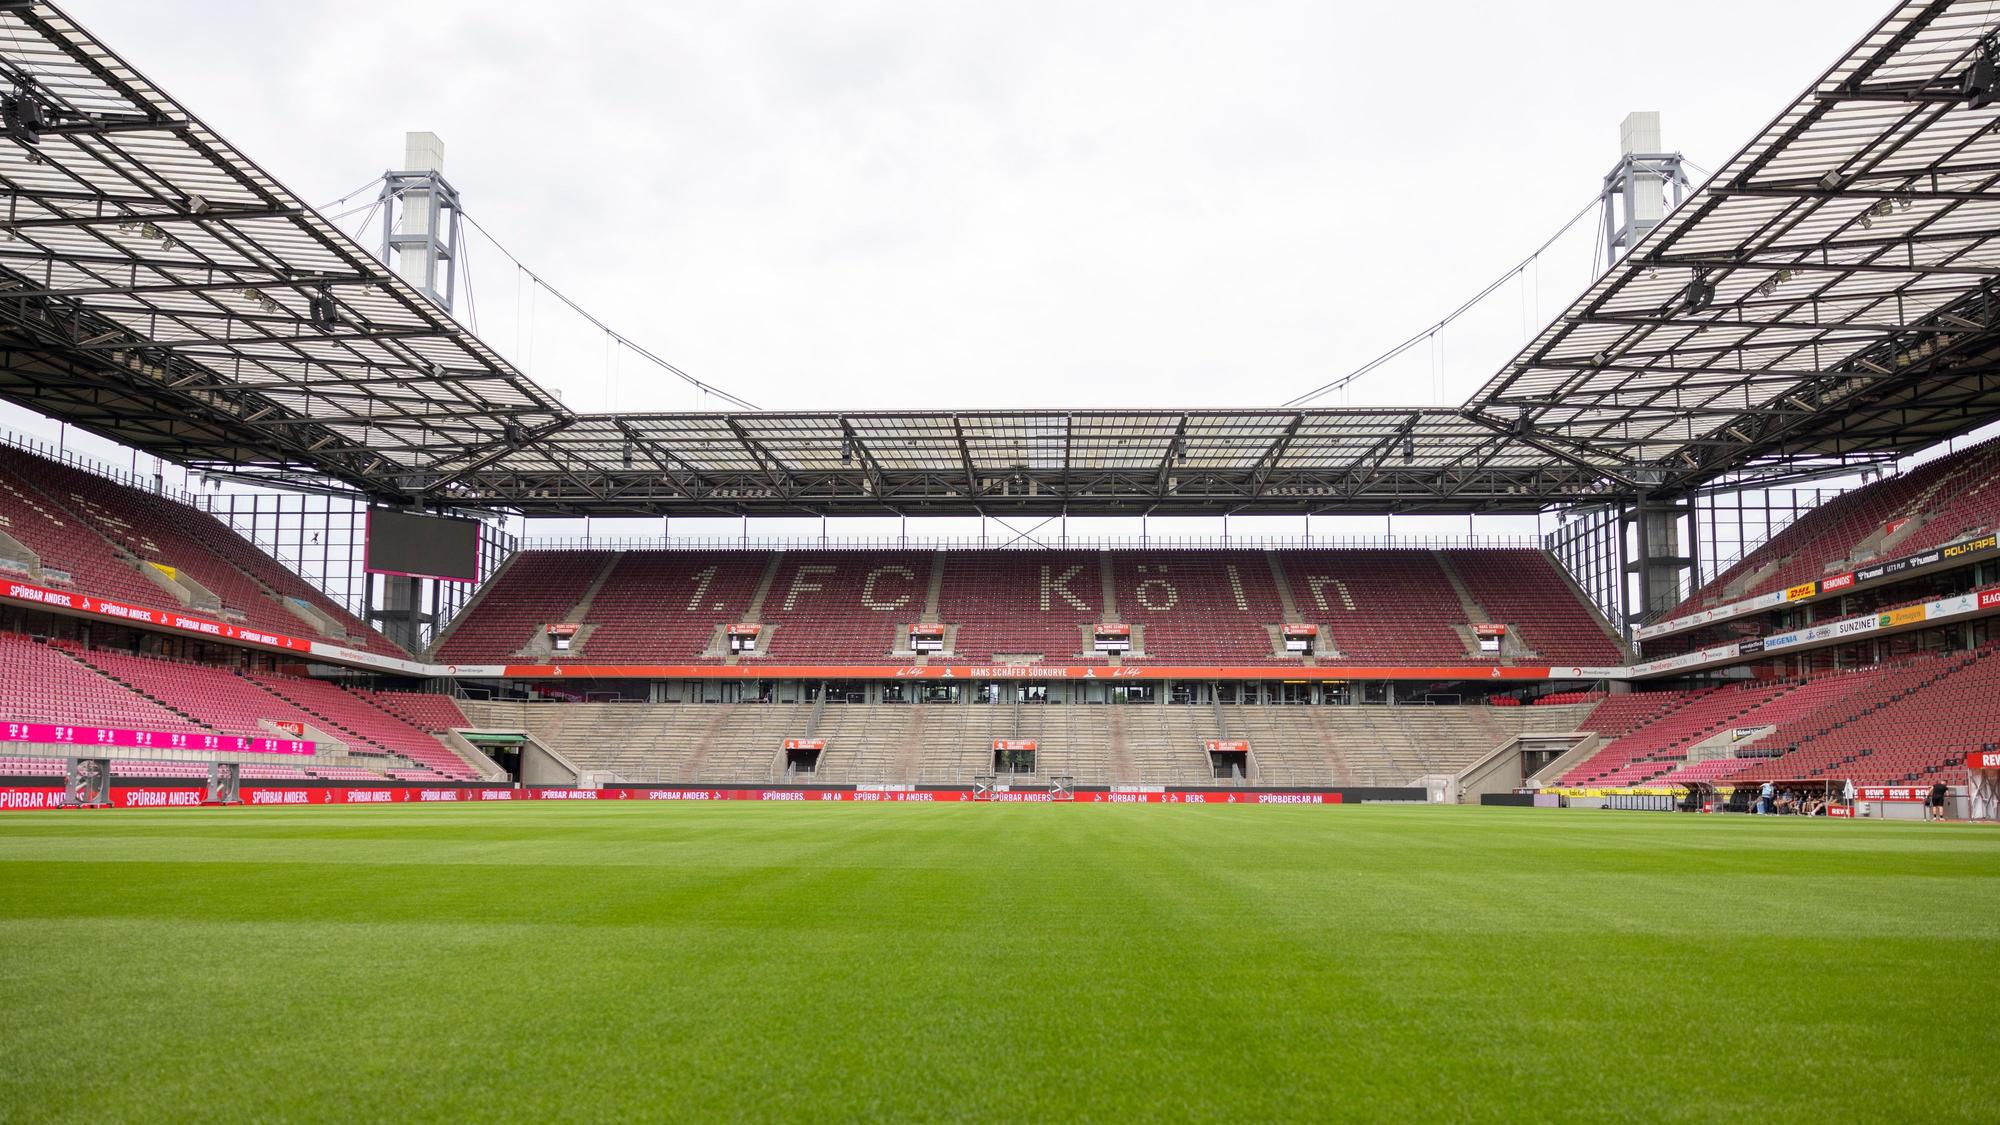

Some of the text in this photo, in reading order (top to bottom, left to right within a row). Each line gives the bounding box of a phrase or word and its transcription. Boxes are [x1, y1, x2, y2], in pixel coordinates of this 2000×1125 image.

[1917, 551, 1939, 566] hummel
[1864, 567, 1884, 579] hummel
[10, 585, 43, 602] SPÜRBAR
[1790, 586, 1811, 598] DHL
[100, 602, 129, 617] SPÜRBAR
[1839, 618, 1876, 633] SUNZINET
[1765, 635, 1798, 648] SIEGENIA
[970, 666, 1067, 677] HANS SCHÄFER SÜDKURVE
[126, 789, 168, 806] SPÜRBAR
[252, 789, 283, 804] SPÜRBAR
[649, 791, 709, 800] SPÜRBAR ANDERS
[1890, 789, 1907, 799] REWE
